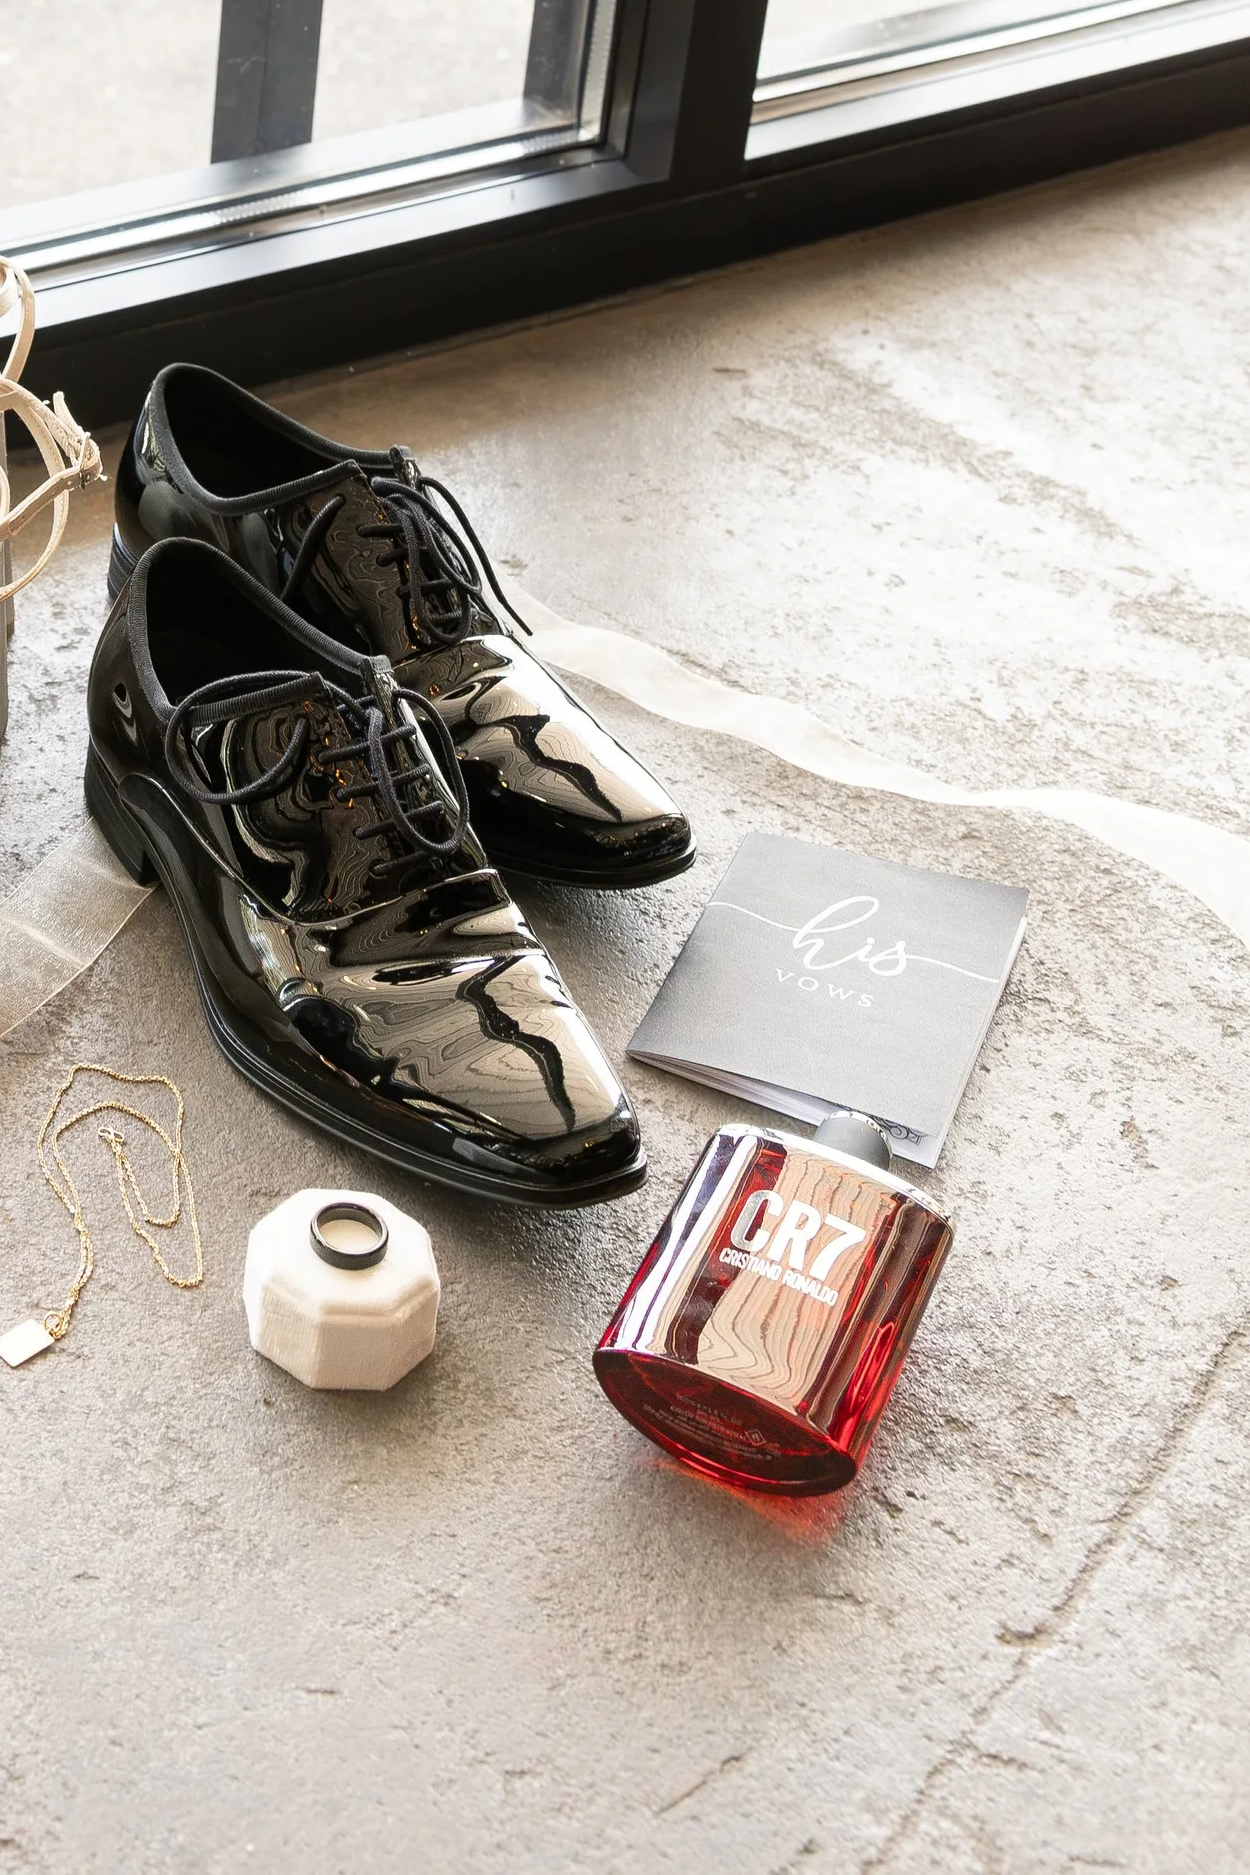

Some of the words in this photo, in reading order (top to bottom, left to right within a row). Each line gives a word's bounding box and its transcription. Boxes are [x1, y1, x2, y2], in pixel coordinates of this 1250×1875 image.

[792, 895, 907, 976] his
[775, 968, 874, 1008] VOWS
[730, 1189, 867, 1282] CR7
[718, 1247, 782, 1281] CRISTIANO
[781, 1269, 839, 1307] RONALDO
